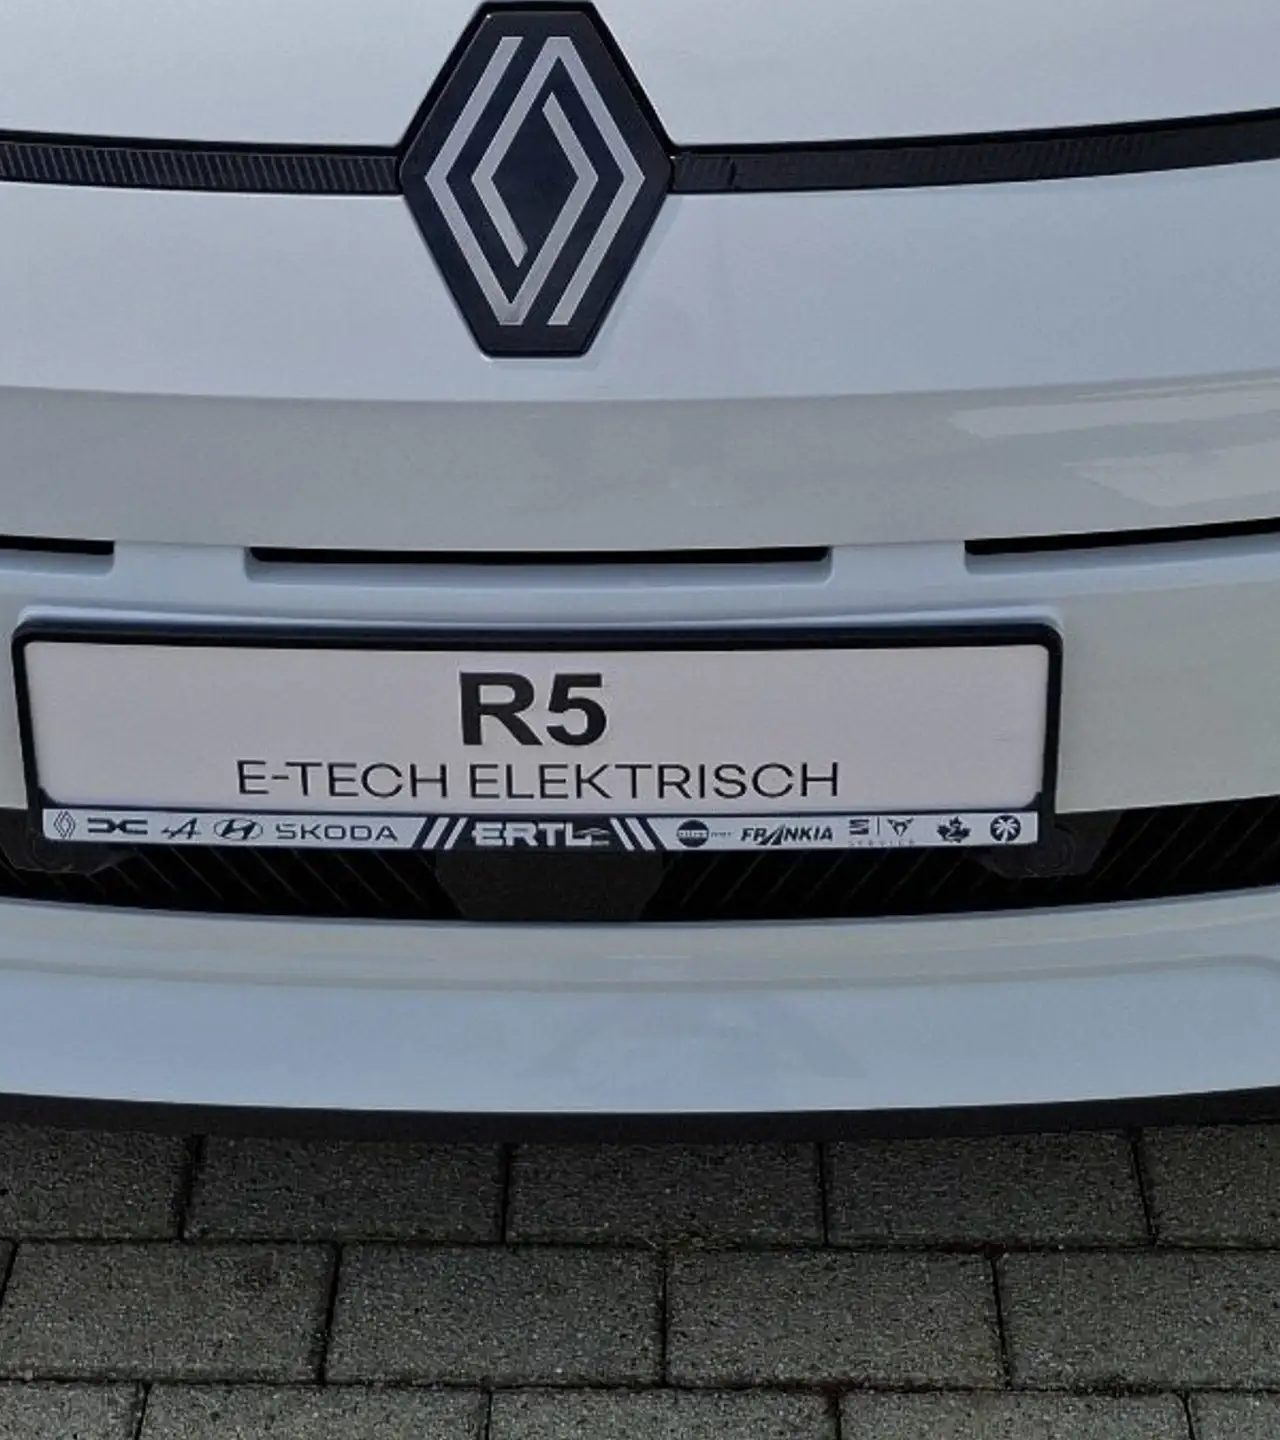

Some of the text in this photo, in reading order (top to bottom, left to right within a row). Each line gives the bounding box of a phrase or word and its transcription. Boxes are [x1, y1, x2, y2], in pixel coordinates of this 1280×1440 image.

[459, 671, 607, 746] R5
[237, 760, 839, 799] E-TECH ELEKTRISCH
[740, 823, 834, 846] FRANKIA
